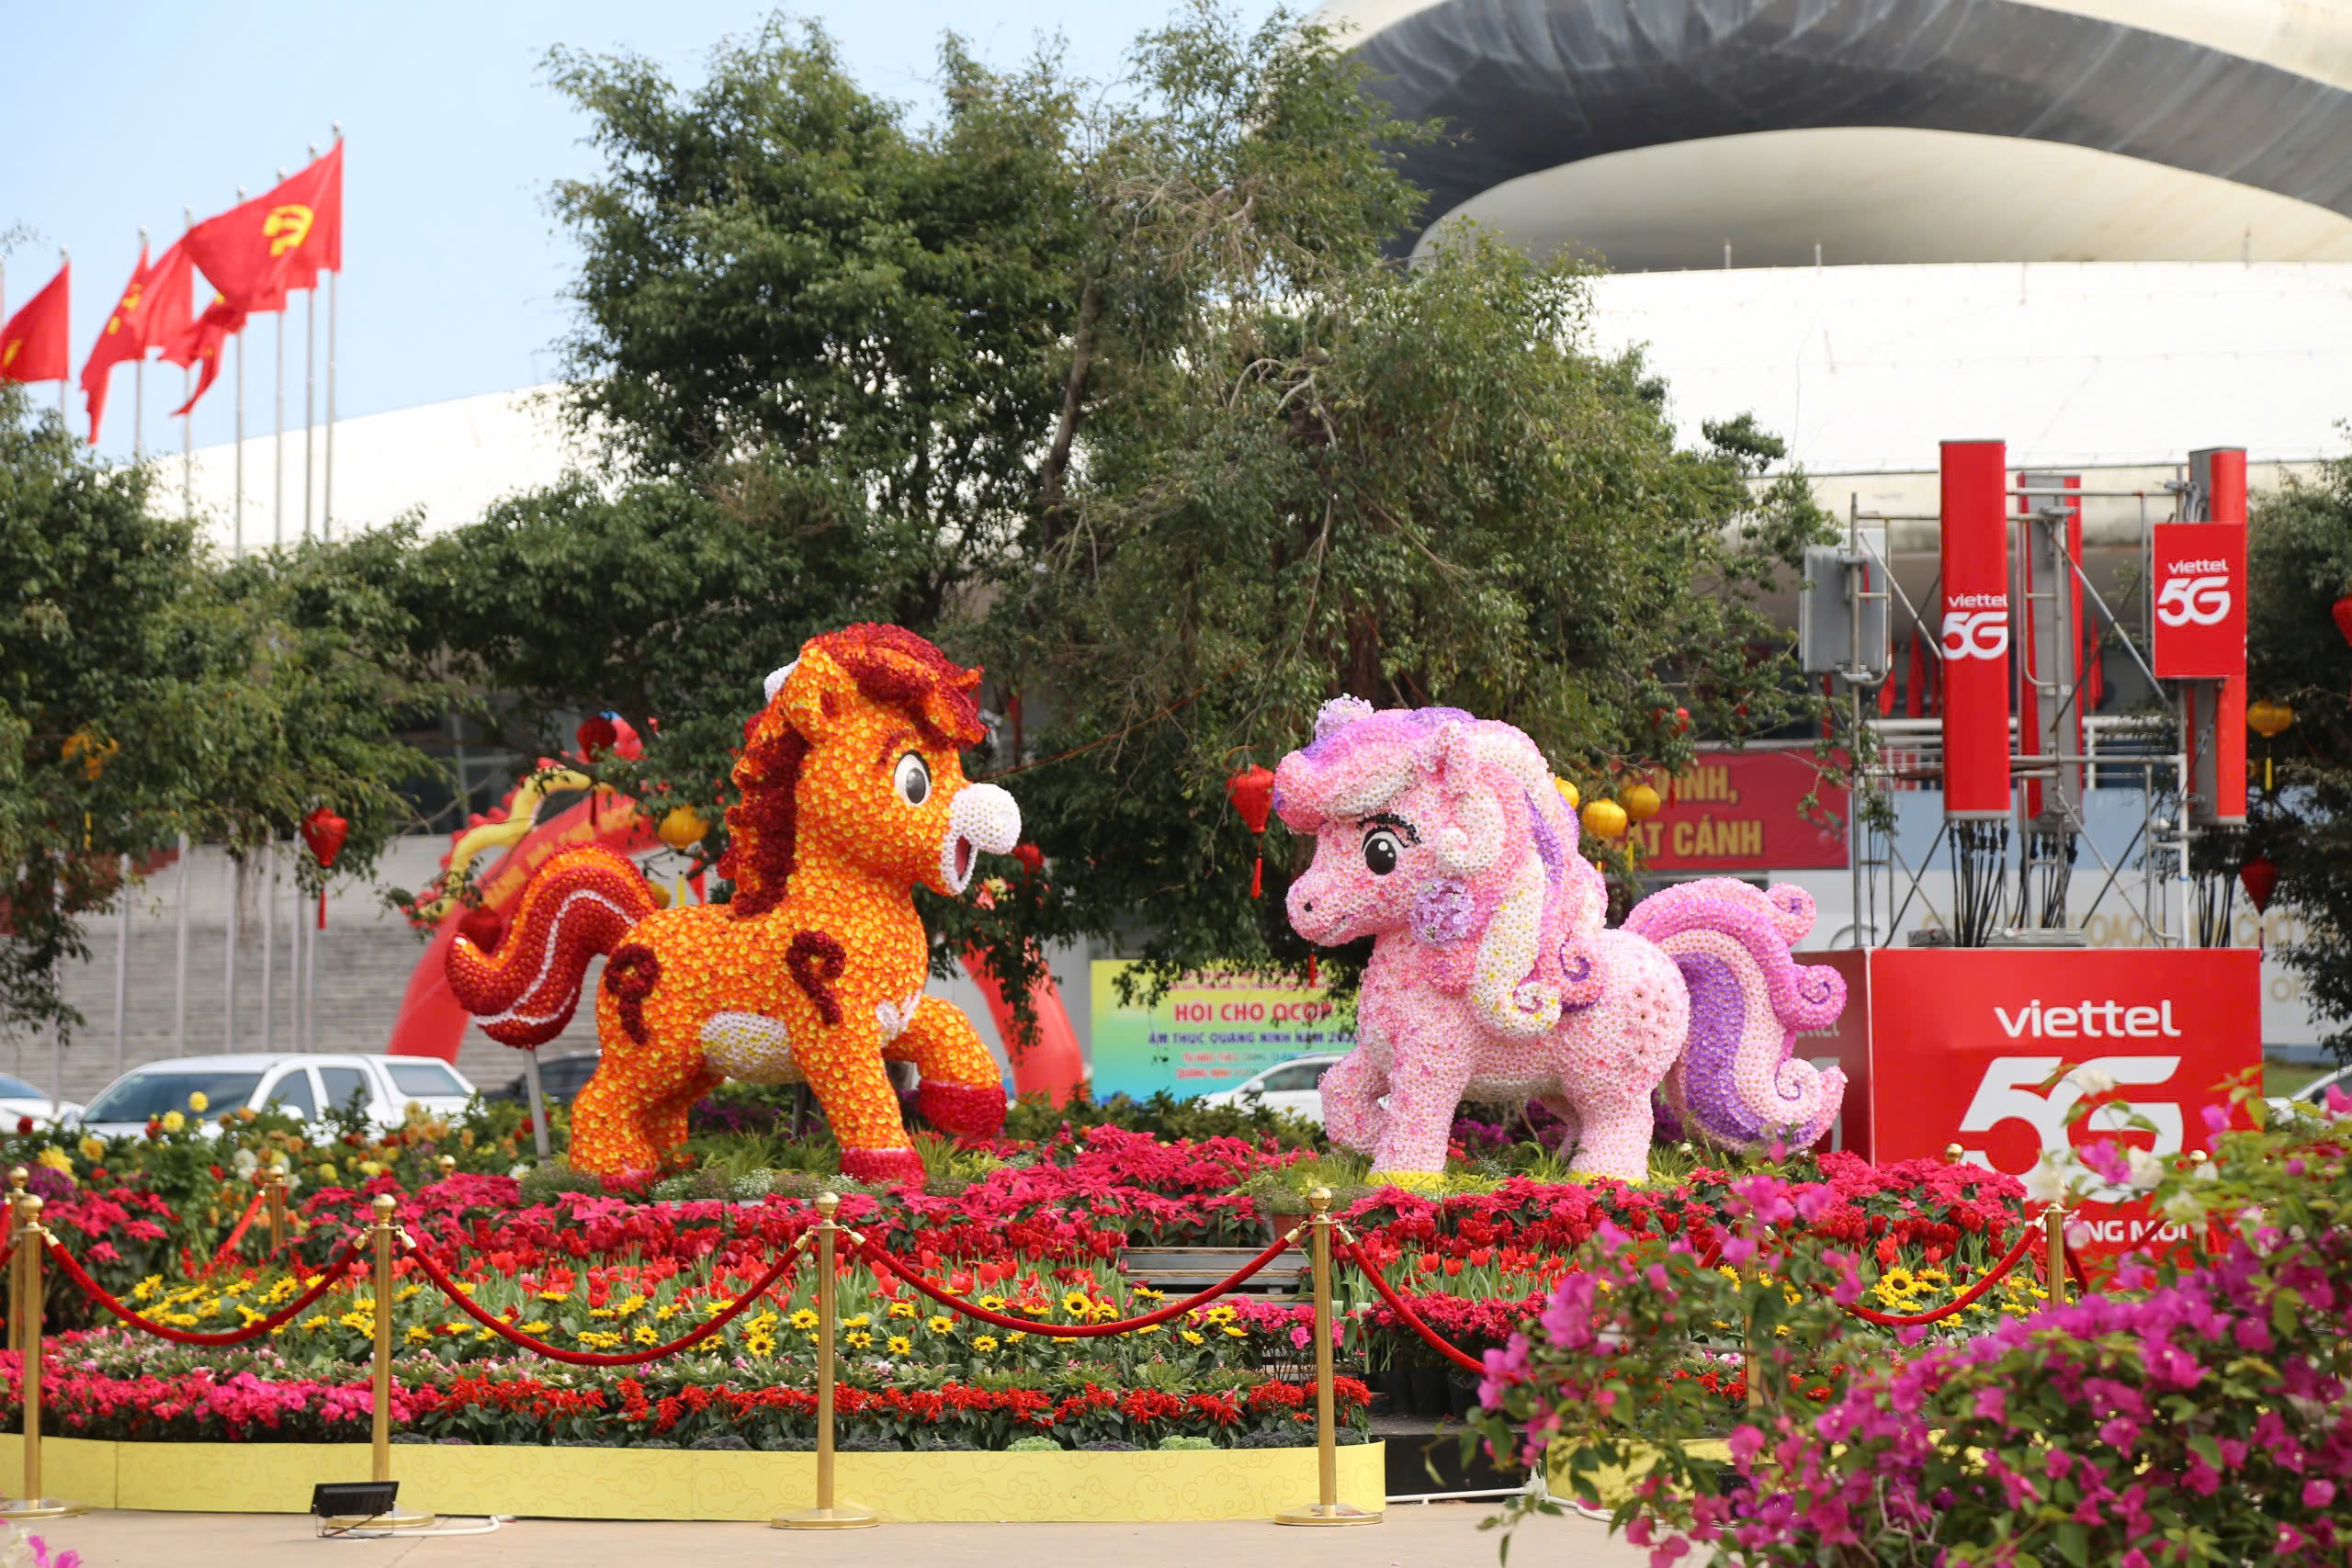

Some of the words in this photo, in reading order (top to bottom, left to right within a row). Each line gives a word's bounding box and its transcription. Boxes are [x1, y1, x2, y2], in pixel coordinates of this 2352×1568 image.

[2168, 558, 2229, 574] viettel
[1948, 593, 2008, 608] viettel
[2157, 576, 2232, 626] 5G
[1941, 612, 2009, 660] 5G
[1673, 814, 1762, 856] CÁNH
[1994, 999, 2182, 1038] viettel
[1959, 1056, 2184, 1203] 5G
